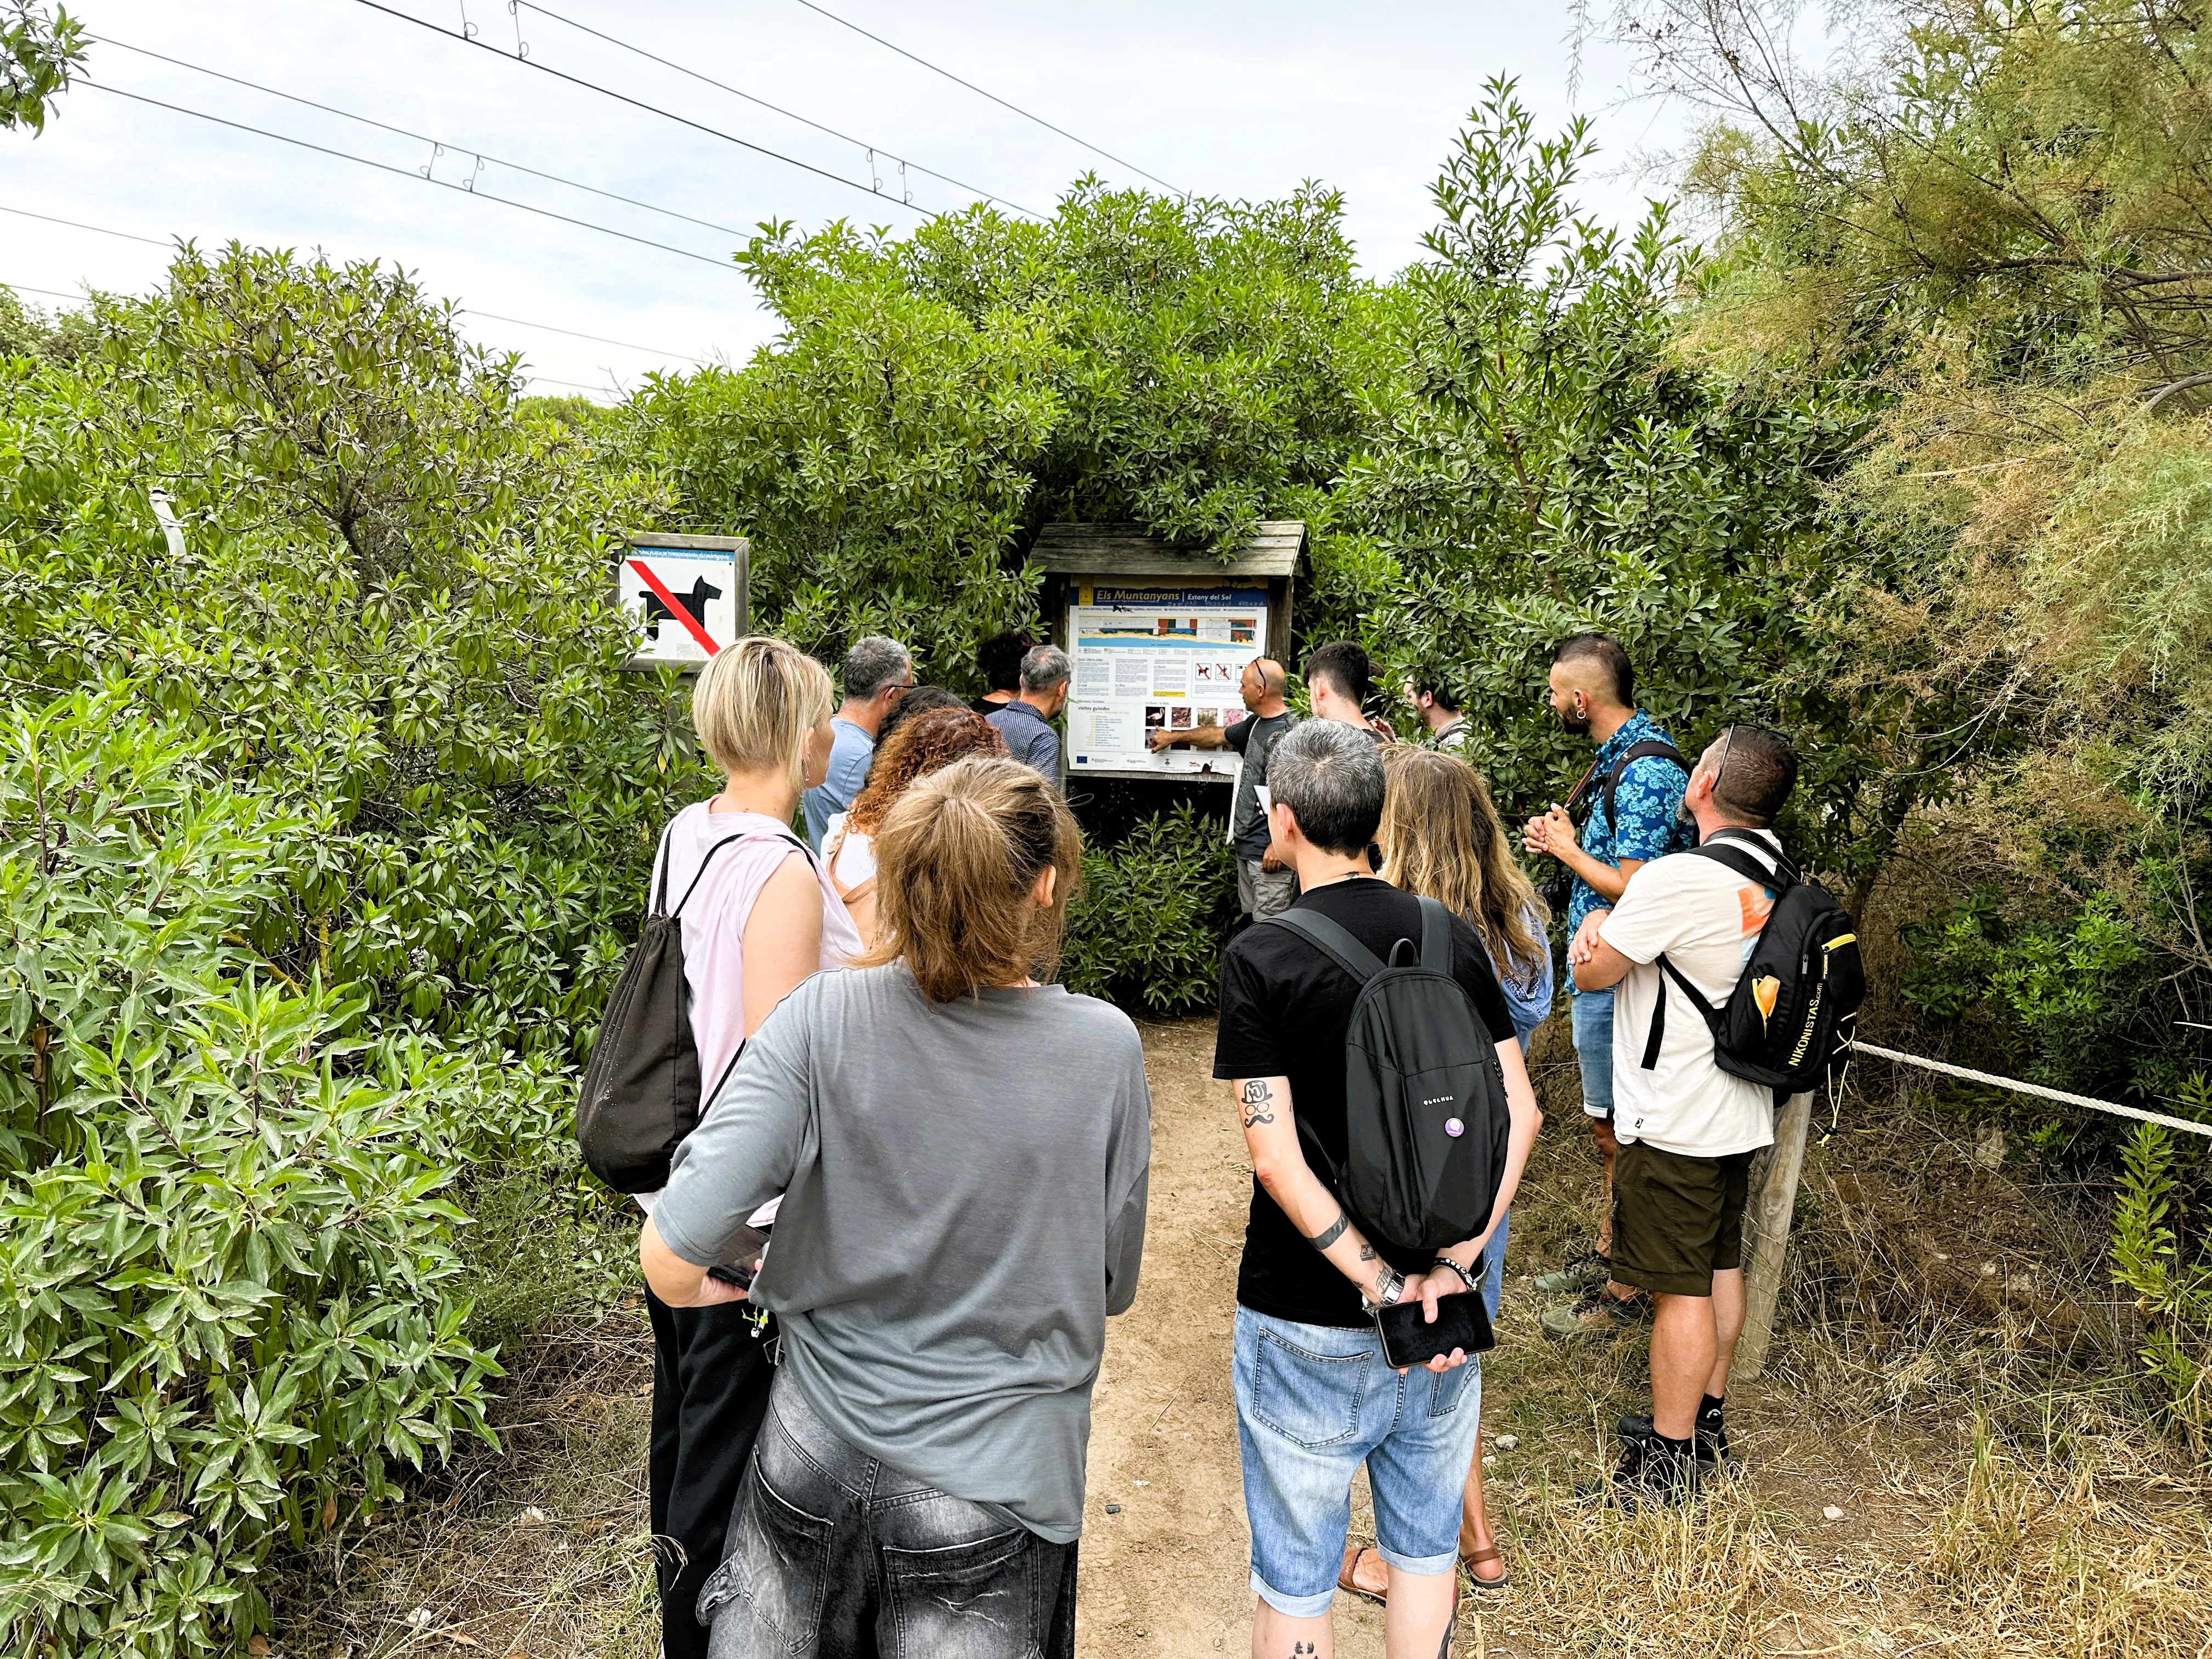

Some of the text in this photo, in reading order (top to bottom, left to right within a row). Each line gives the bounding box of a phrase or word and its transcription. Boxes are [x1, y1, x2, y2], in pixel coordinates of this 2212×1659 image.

[1097, 590, 1111, 600] Els
[1114, 590, 1180, 602] Muntanyans
[1788, 983, 1823, 1066] NIKONISTAS.com
[1423, 1096, 1453, 1106] QUECHUA
